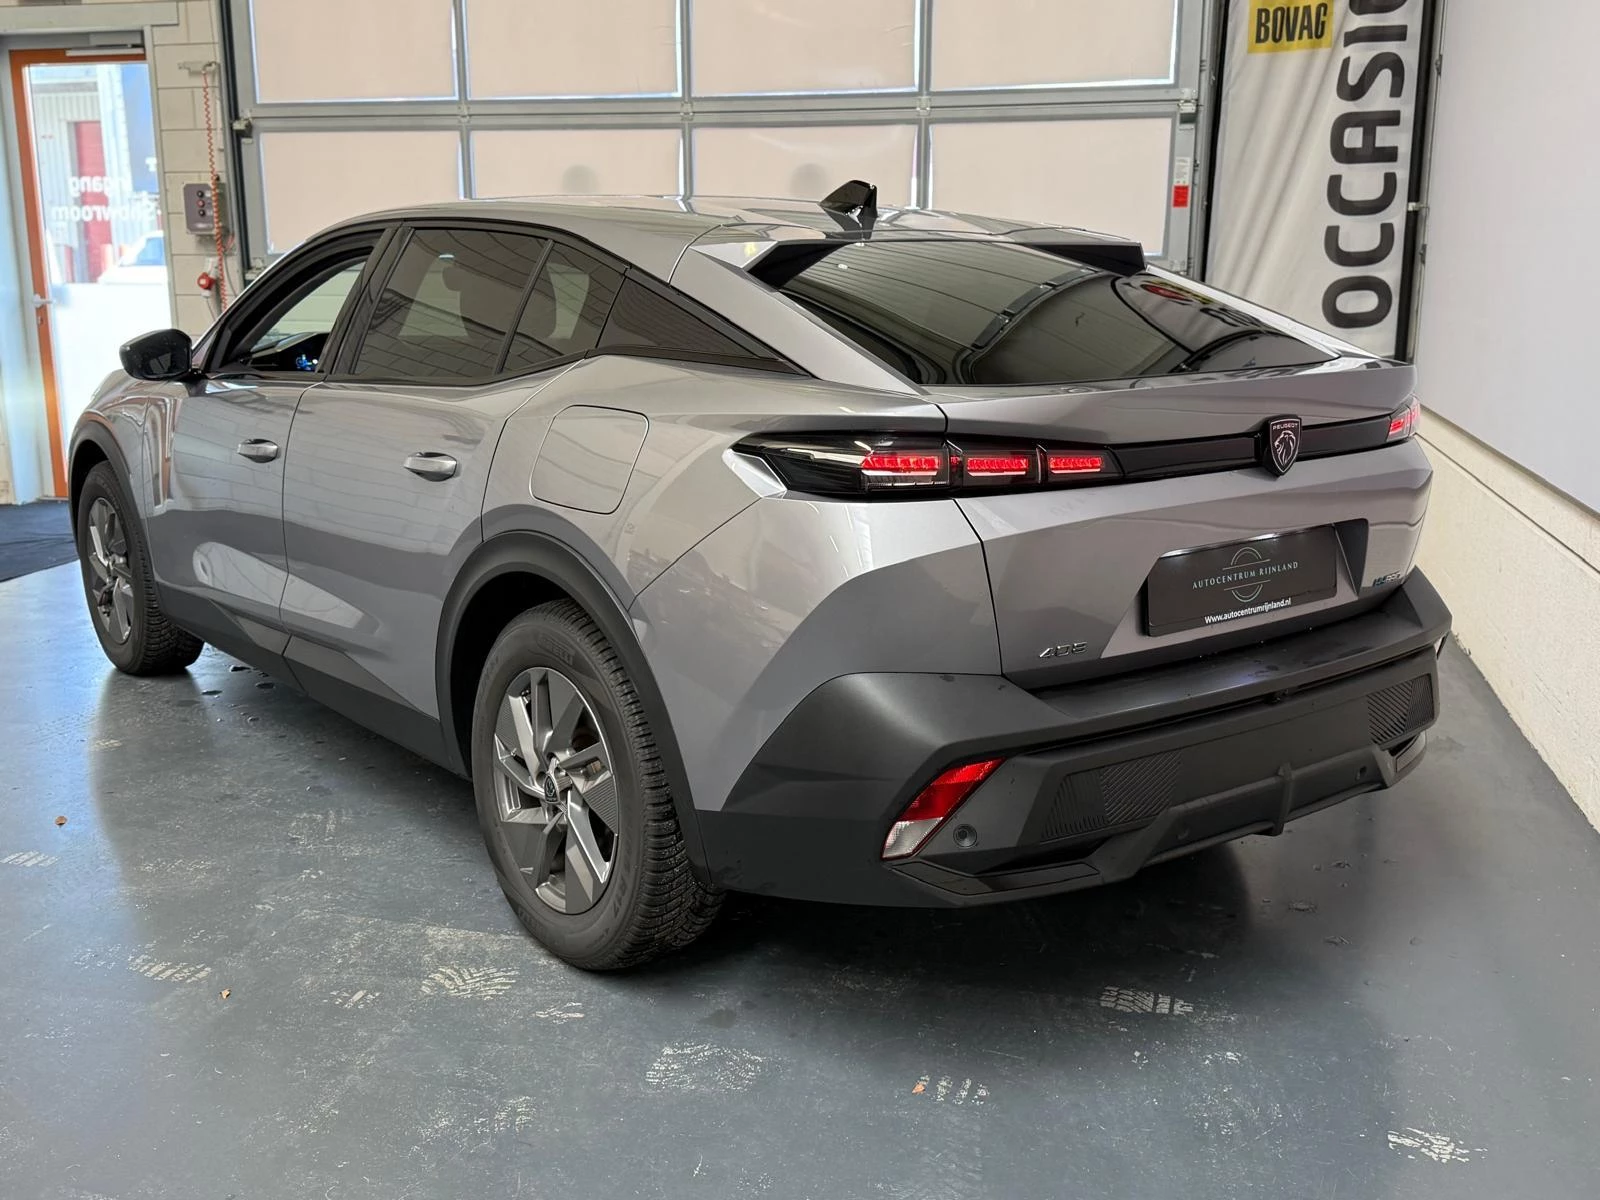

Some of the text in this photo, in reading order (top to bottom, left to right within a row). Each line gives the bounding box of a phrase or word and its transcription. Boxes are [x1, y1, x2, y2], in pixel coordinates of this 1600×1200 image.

[1255, 3, 1328, 44] BOVAG
[1272, 422, 1298, 431] PEUGEOT
[1192, 561, 1299, 590] AUTOCENTRUM RIJNLAND
[1204, 597, 1292, 624] Www.autocentrumrijnland.nl
